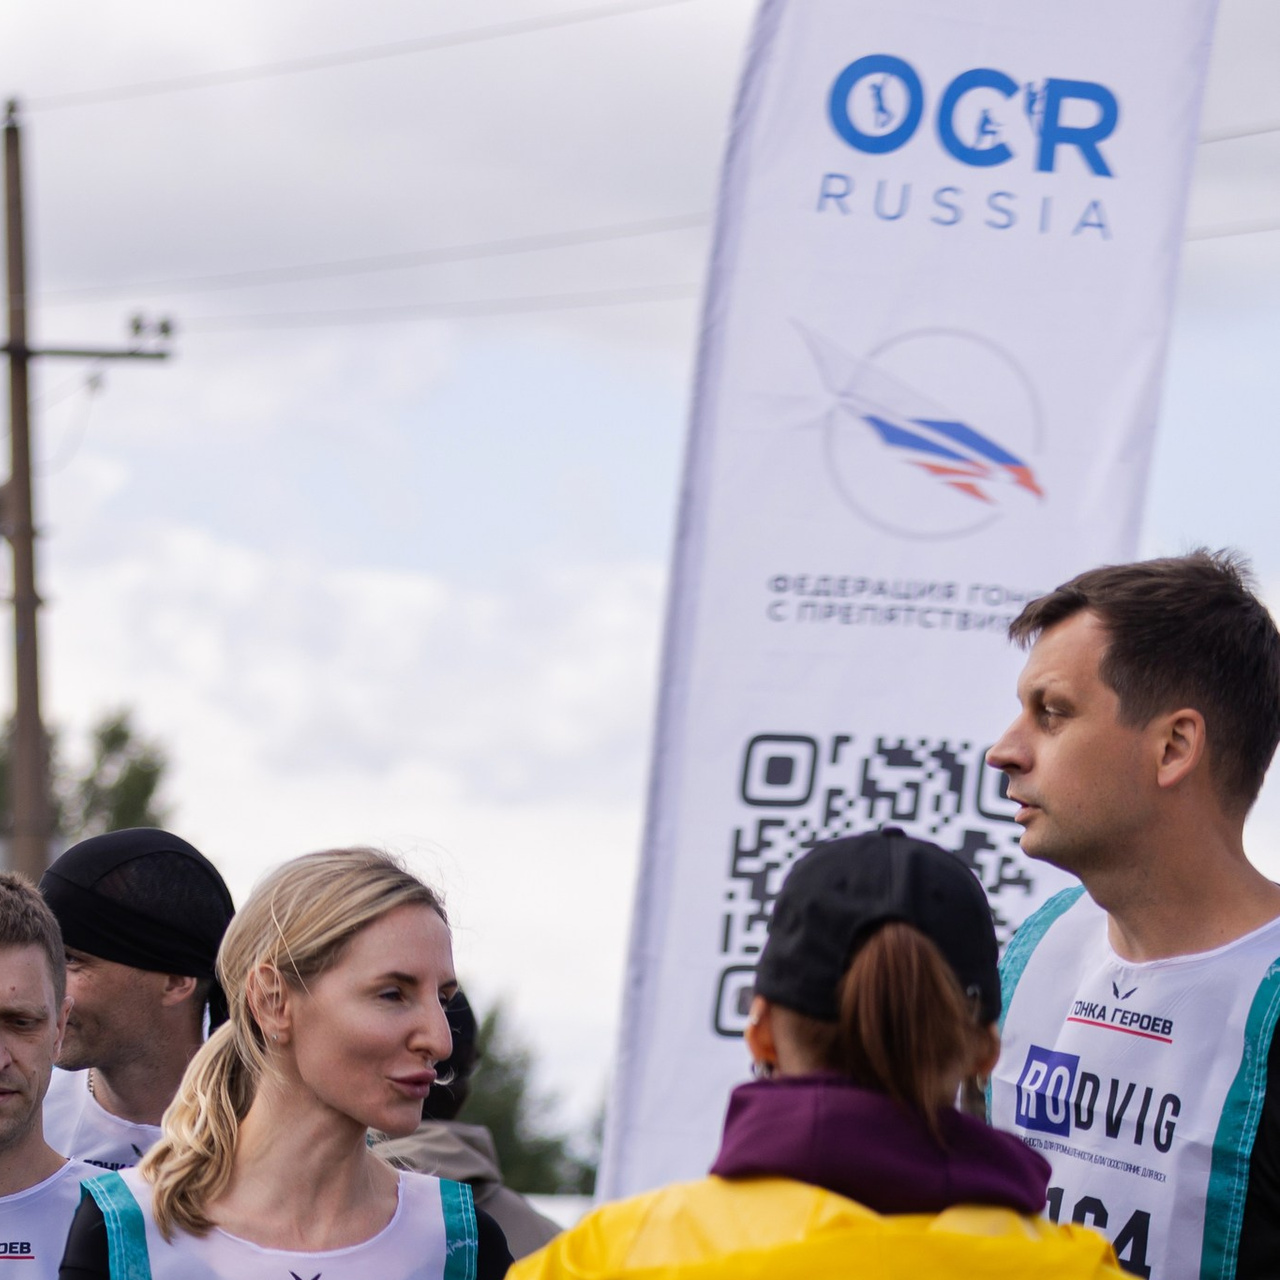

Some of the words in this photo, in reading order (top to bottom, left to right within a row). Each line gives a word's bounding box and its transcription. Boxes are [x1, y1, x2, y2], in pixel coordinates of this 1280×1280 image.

[827, 53, 1120, 179] OCR
[816, 172, 1113, 240] RUSSIA
[766, 599, 789, 622] С
[1110, 1008, 1174, 1036] ГЕРОЕВ
[1019, 1059, 1182, 1153] RODVIG
